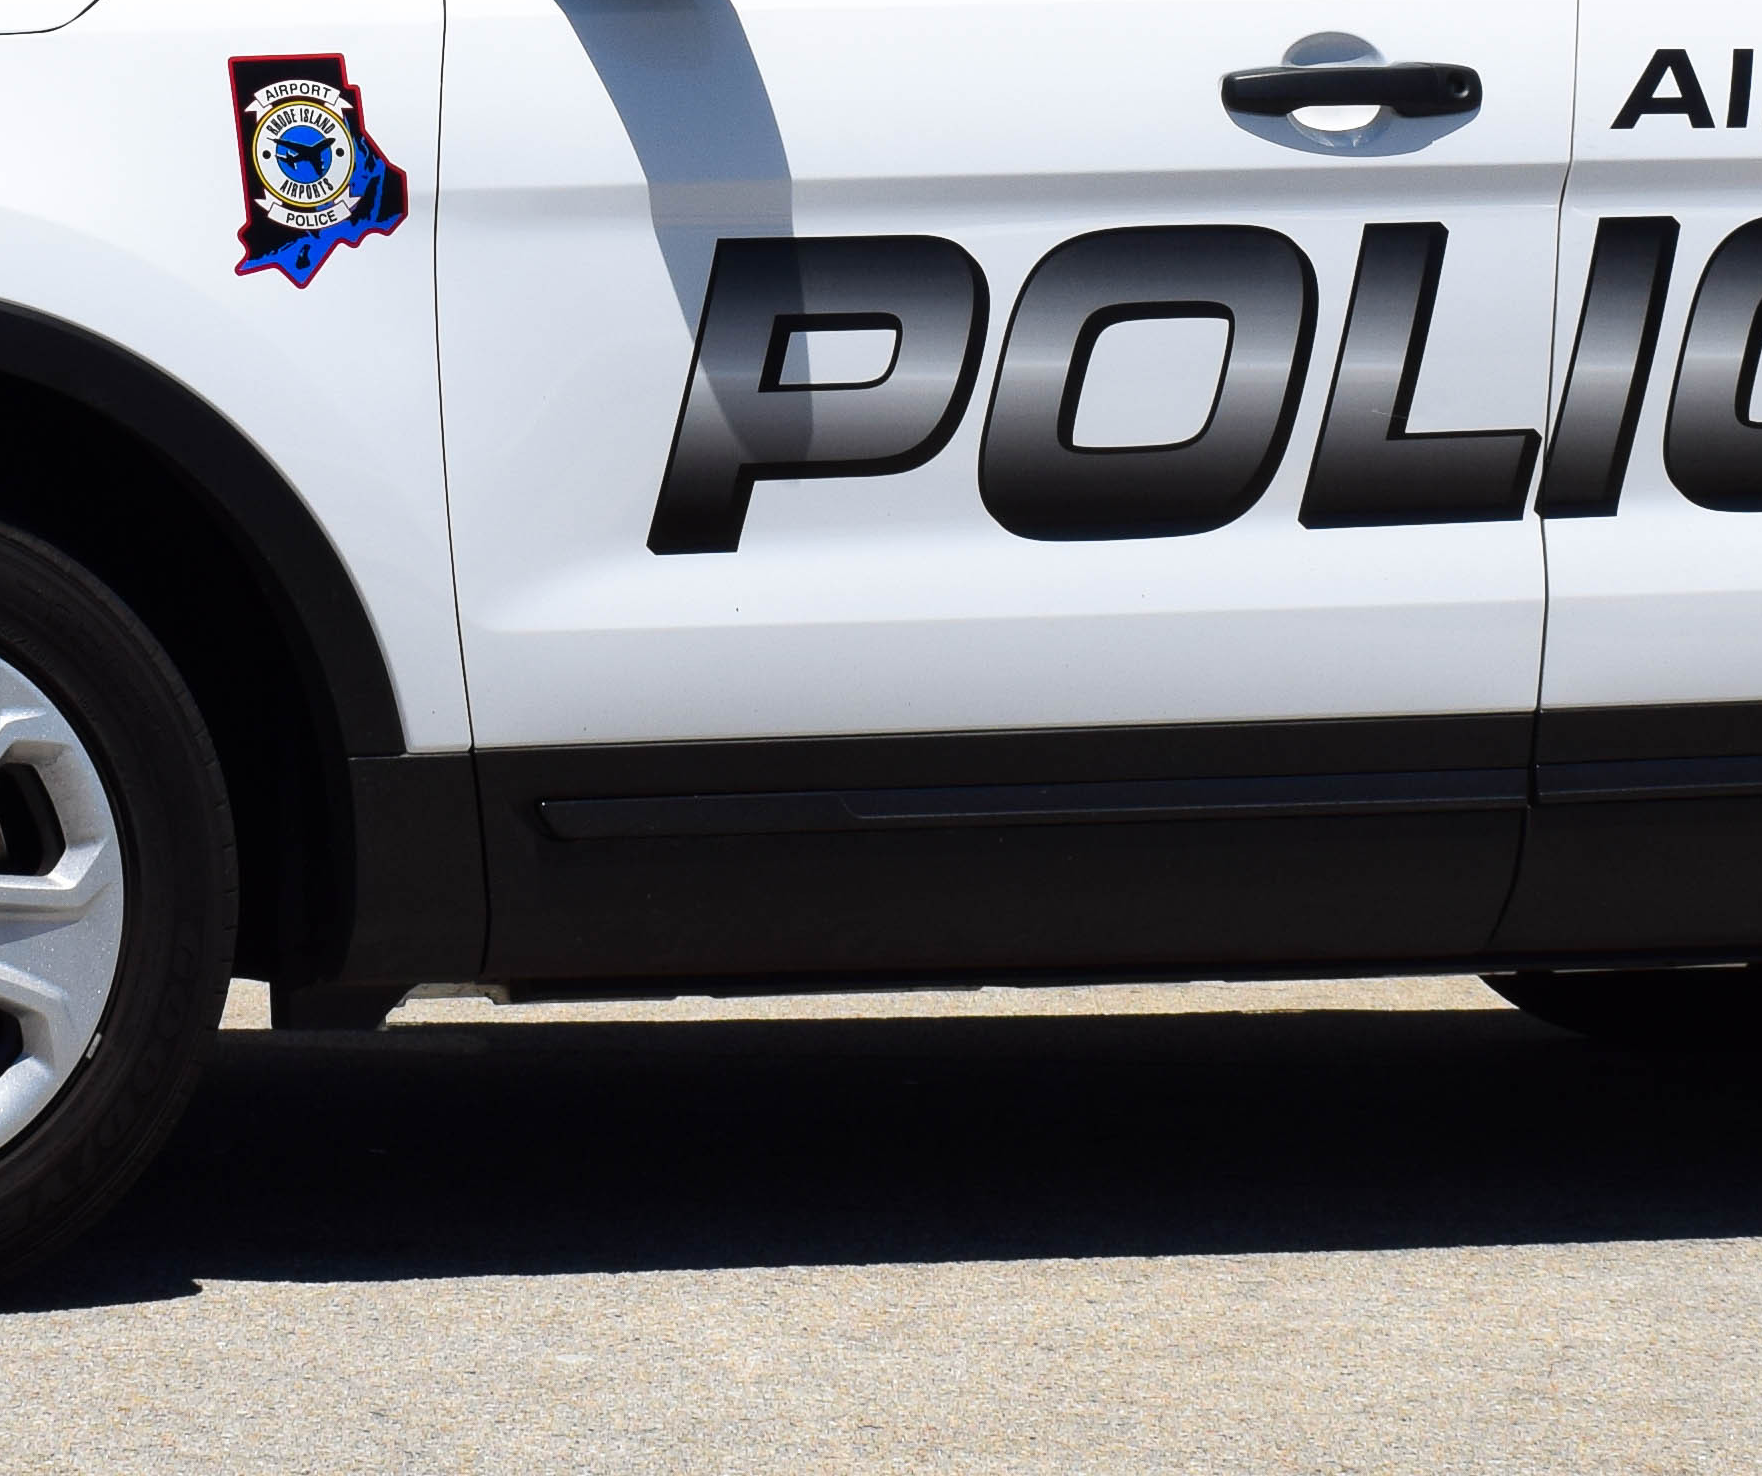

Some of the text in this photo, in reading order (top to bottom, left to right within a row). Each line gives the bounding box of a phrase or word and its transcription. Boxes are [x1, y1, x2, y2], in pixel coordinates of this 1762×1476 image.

[265, 83, 332, 101] AIRPORT
[266, 108, 336, 136] RHODE ISLAND
[279, 178, 334, 199] AIRPORTS
[285, 210, 338, 227] POLICE
